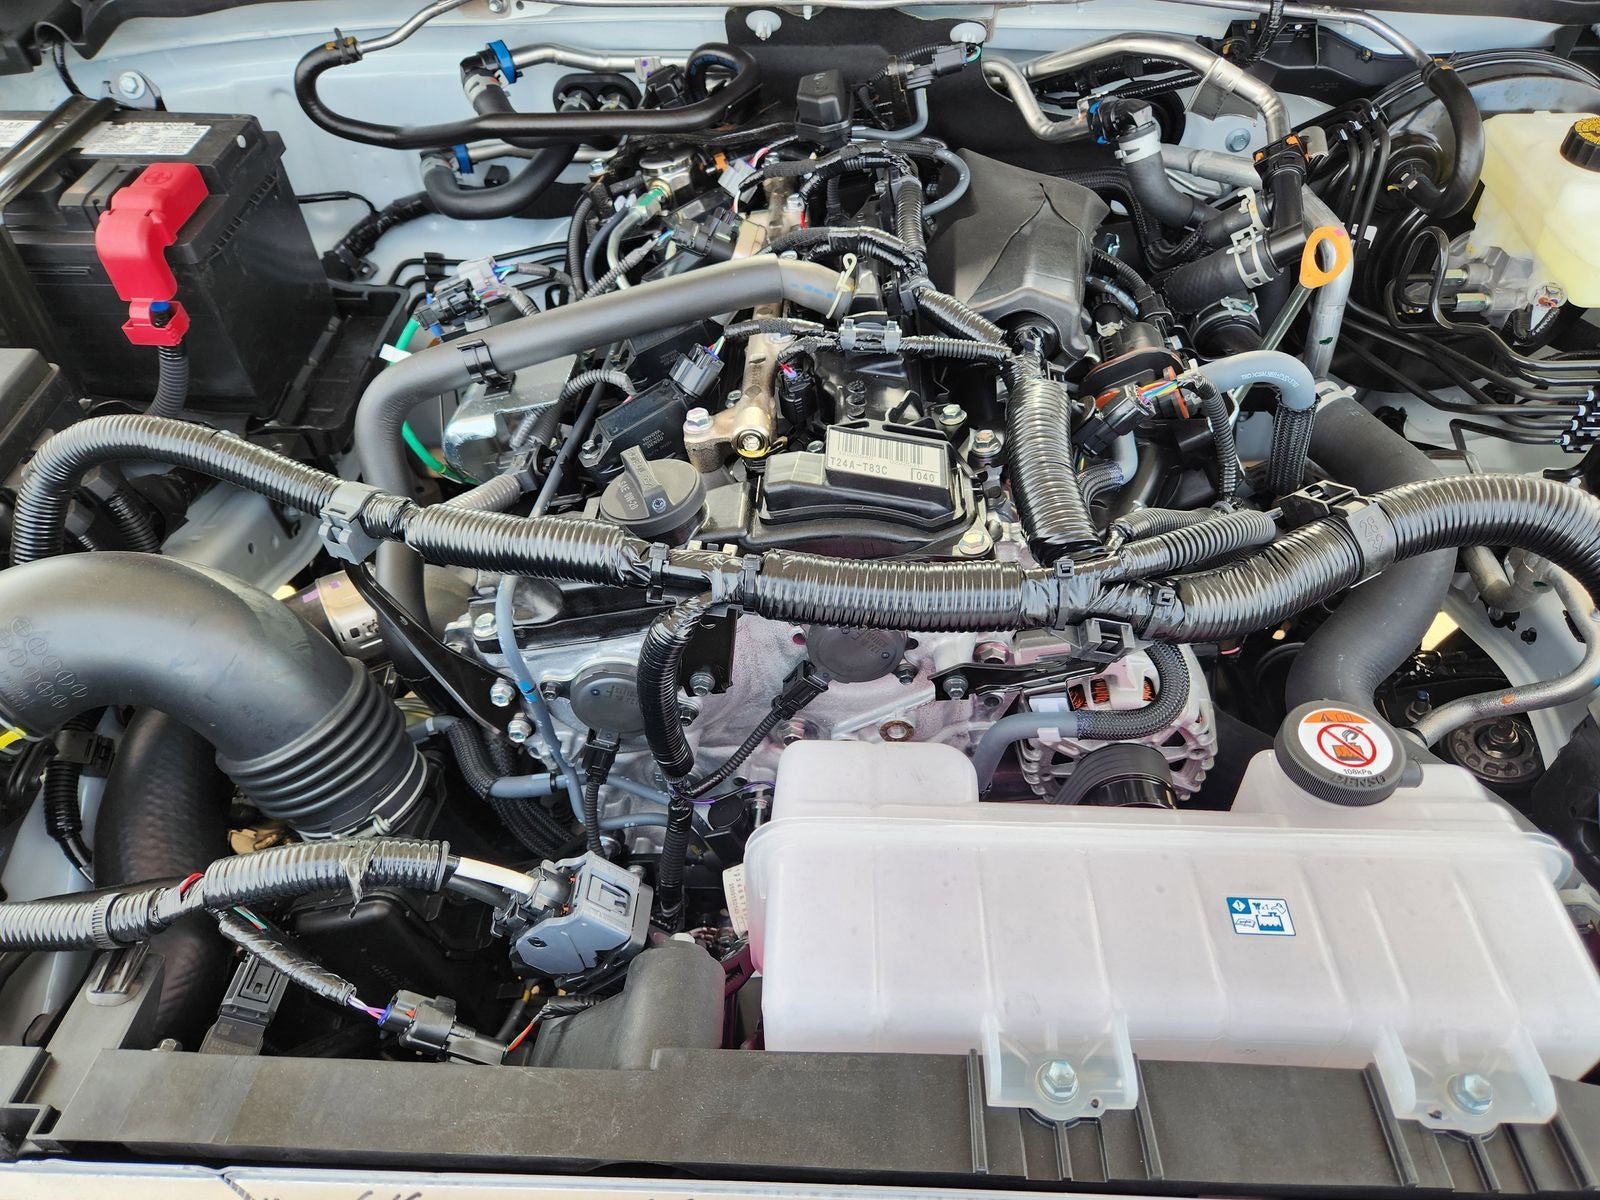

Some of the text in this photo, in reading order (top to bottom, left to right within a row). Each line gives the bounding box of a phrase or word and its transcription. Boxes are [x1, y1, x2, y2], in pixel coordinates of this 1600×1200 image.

[829, 456, 888, 475] T24A-T83C
[916, 472, 936, 483] 040
[1360, 516, 1378, 538] 28
